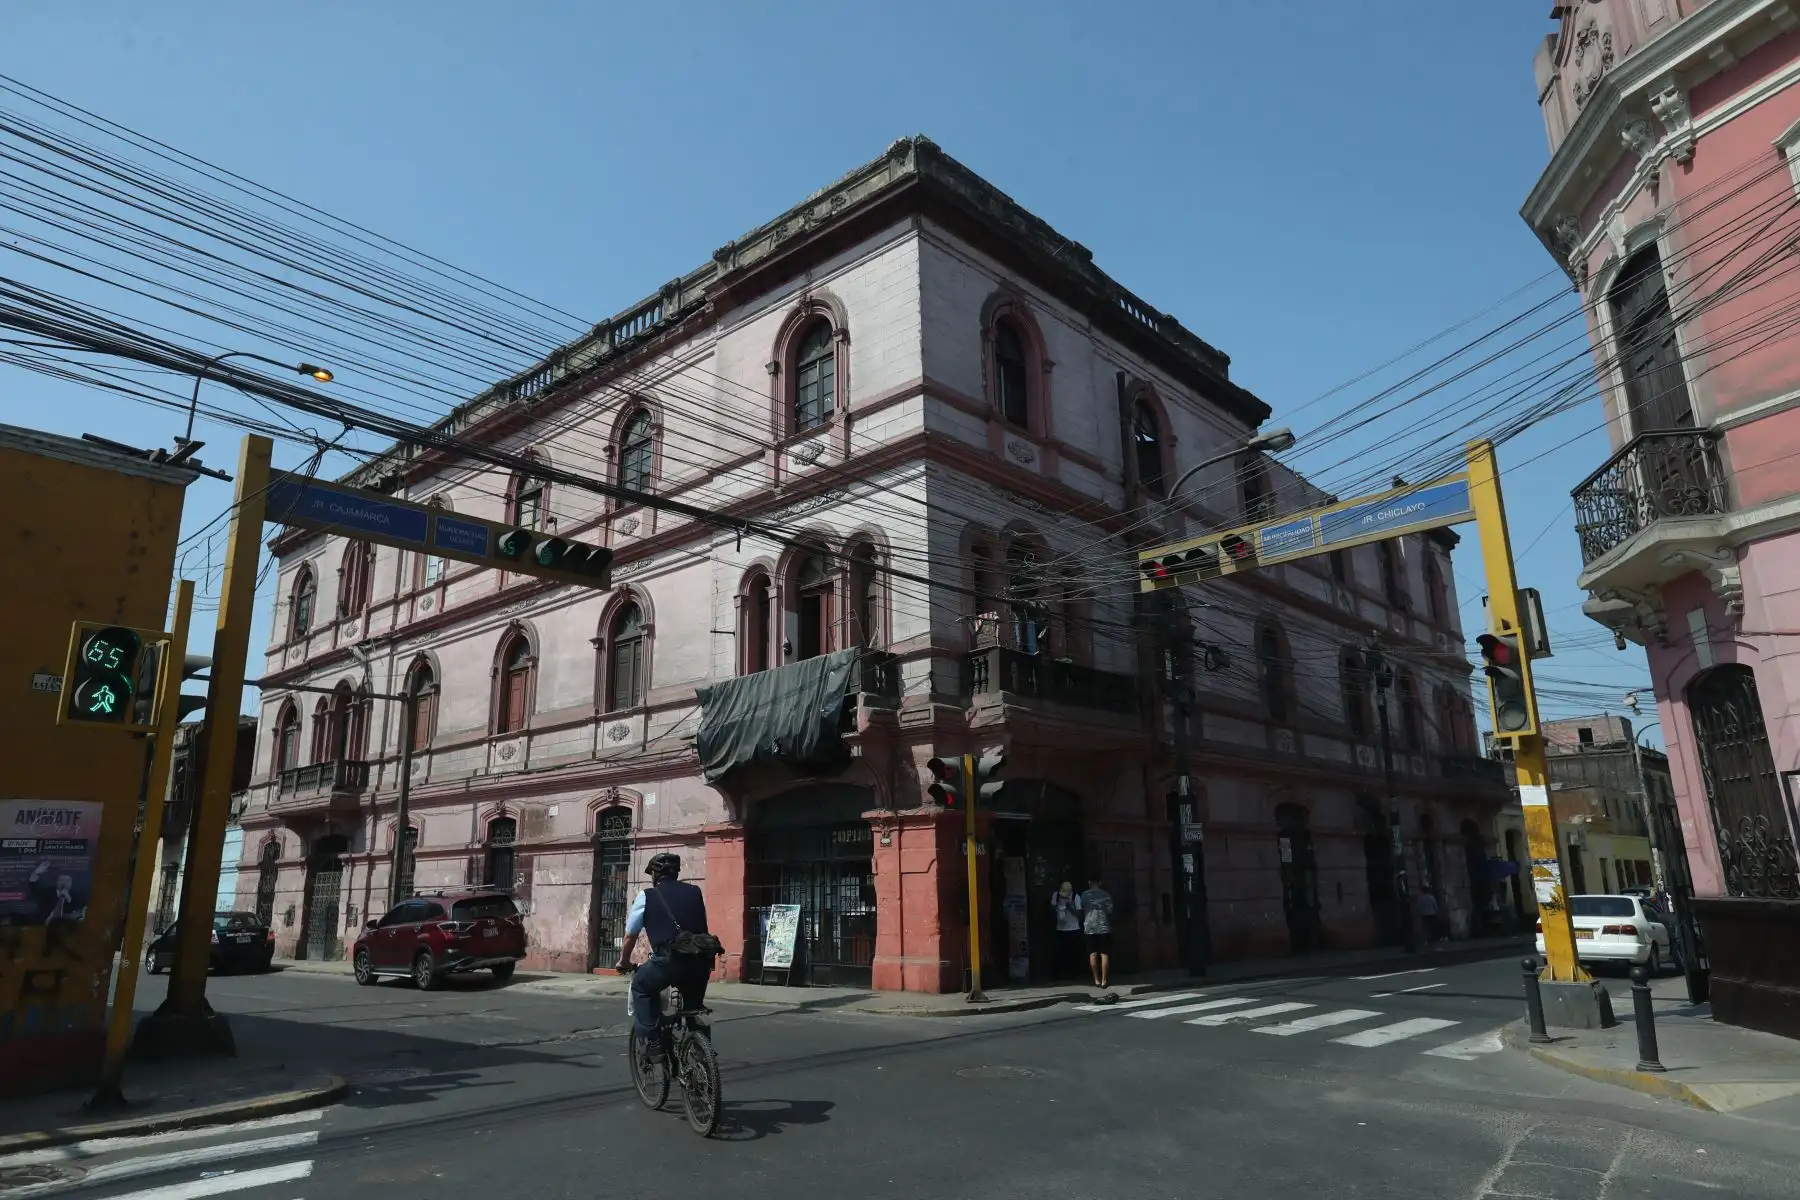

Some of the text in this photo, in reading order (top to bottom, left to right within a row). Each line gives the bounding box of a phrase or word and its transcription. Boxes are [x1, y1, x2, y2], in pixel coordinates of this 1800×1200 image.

[329, 503, 391, 524] CAJAMARCA
[1377, 502, 1426, 520] CHICLAYO
[87, 639, 125, 669] 65
